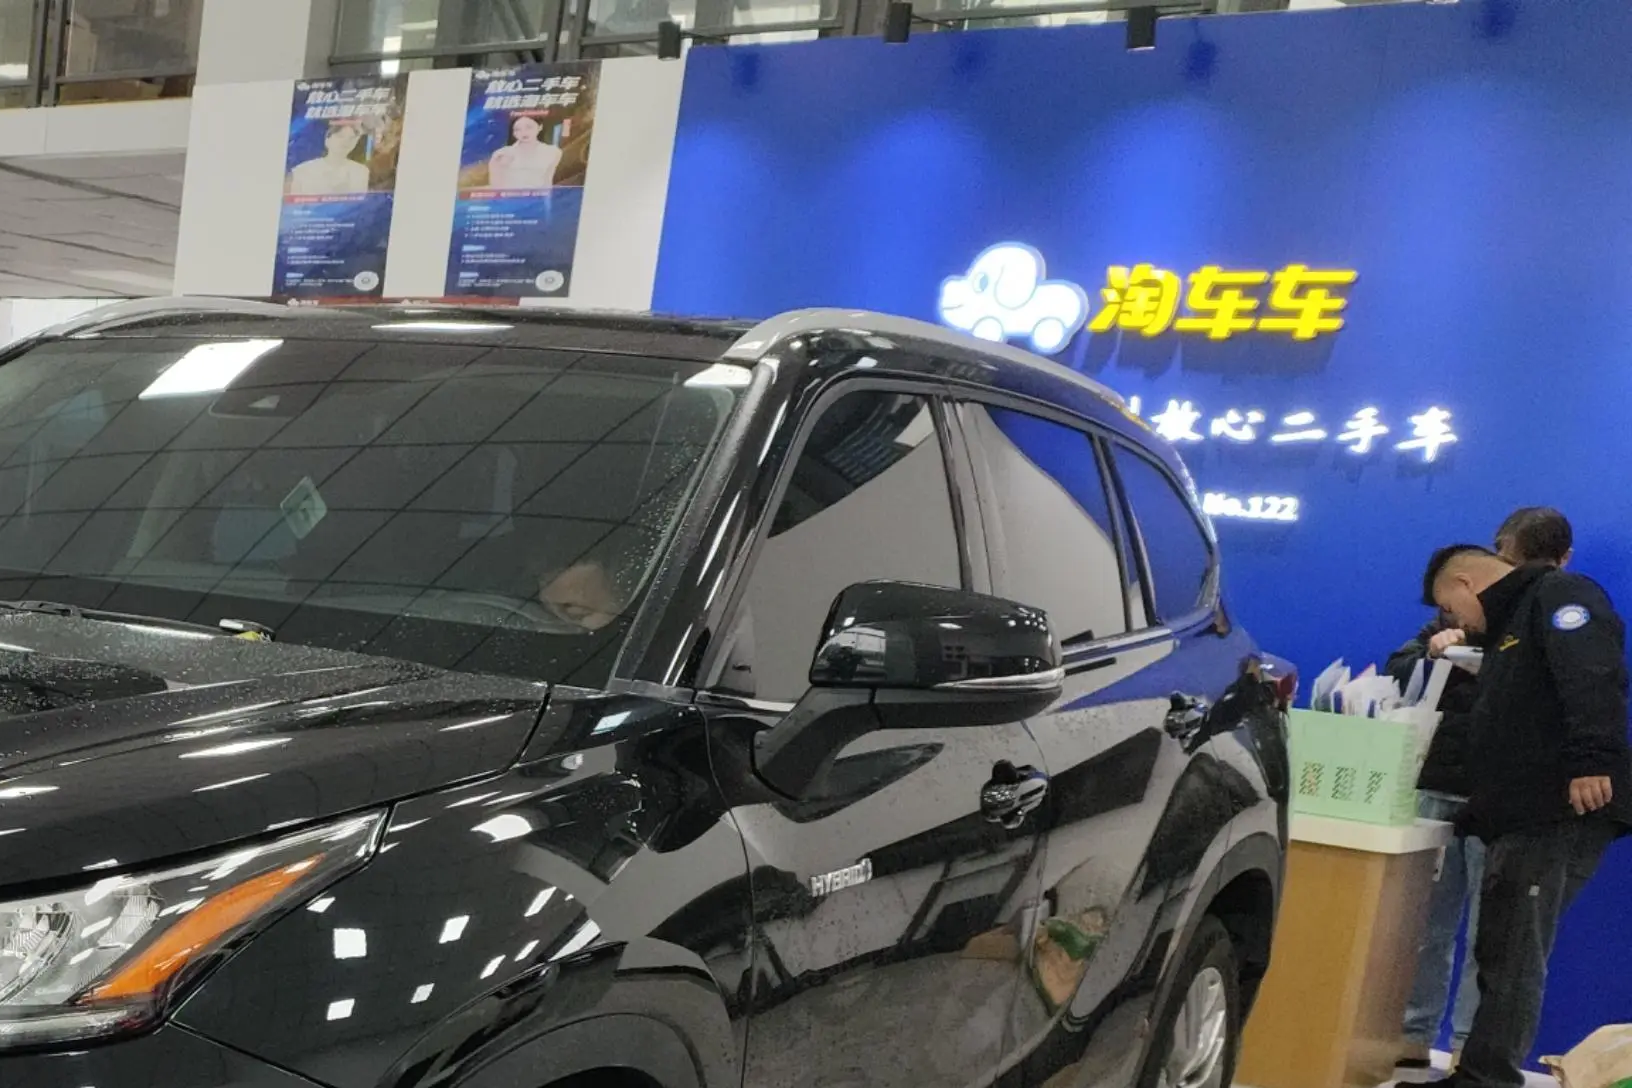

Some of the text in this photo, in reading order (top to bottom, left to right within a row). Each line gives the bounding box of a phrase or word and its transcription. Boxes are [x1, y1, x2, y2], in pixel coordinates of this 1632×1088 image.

[1089, 263, 1359, 341] 淘车车
[1129, 395, 1459, 462] 放心二手车
